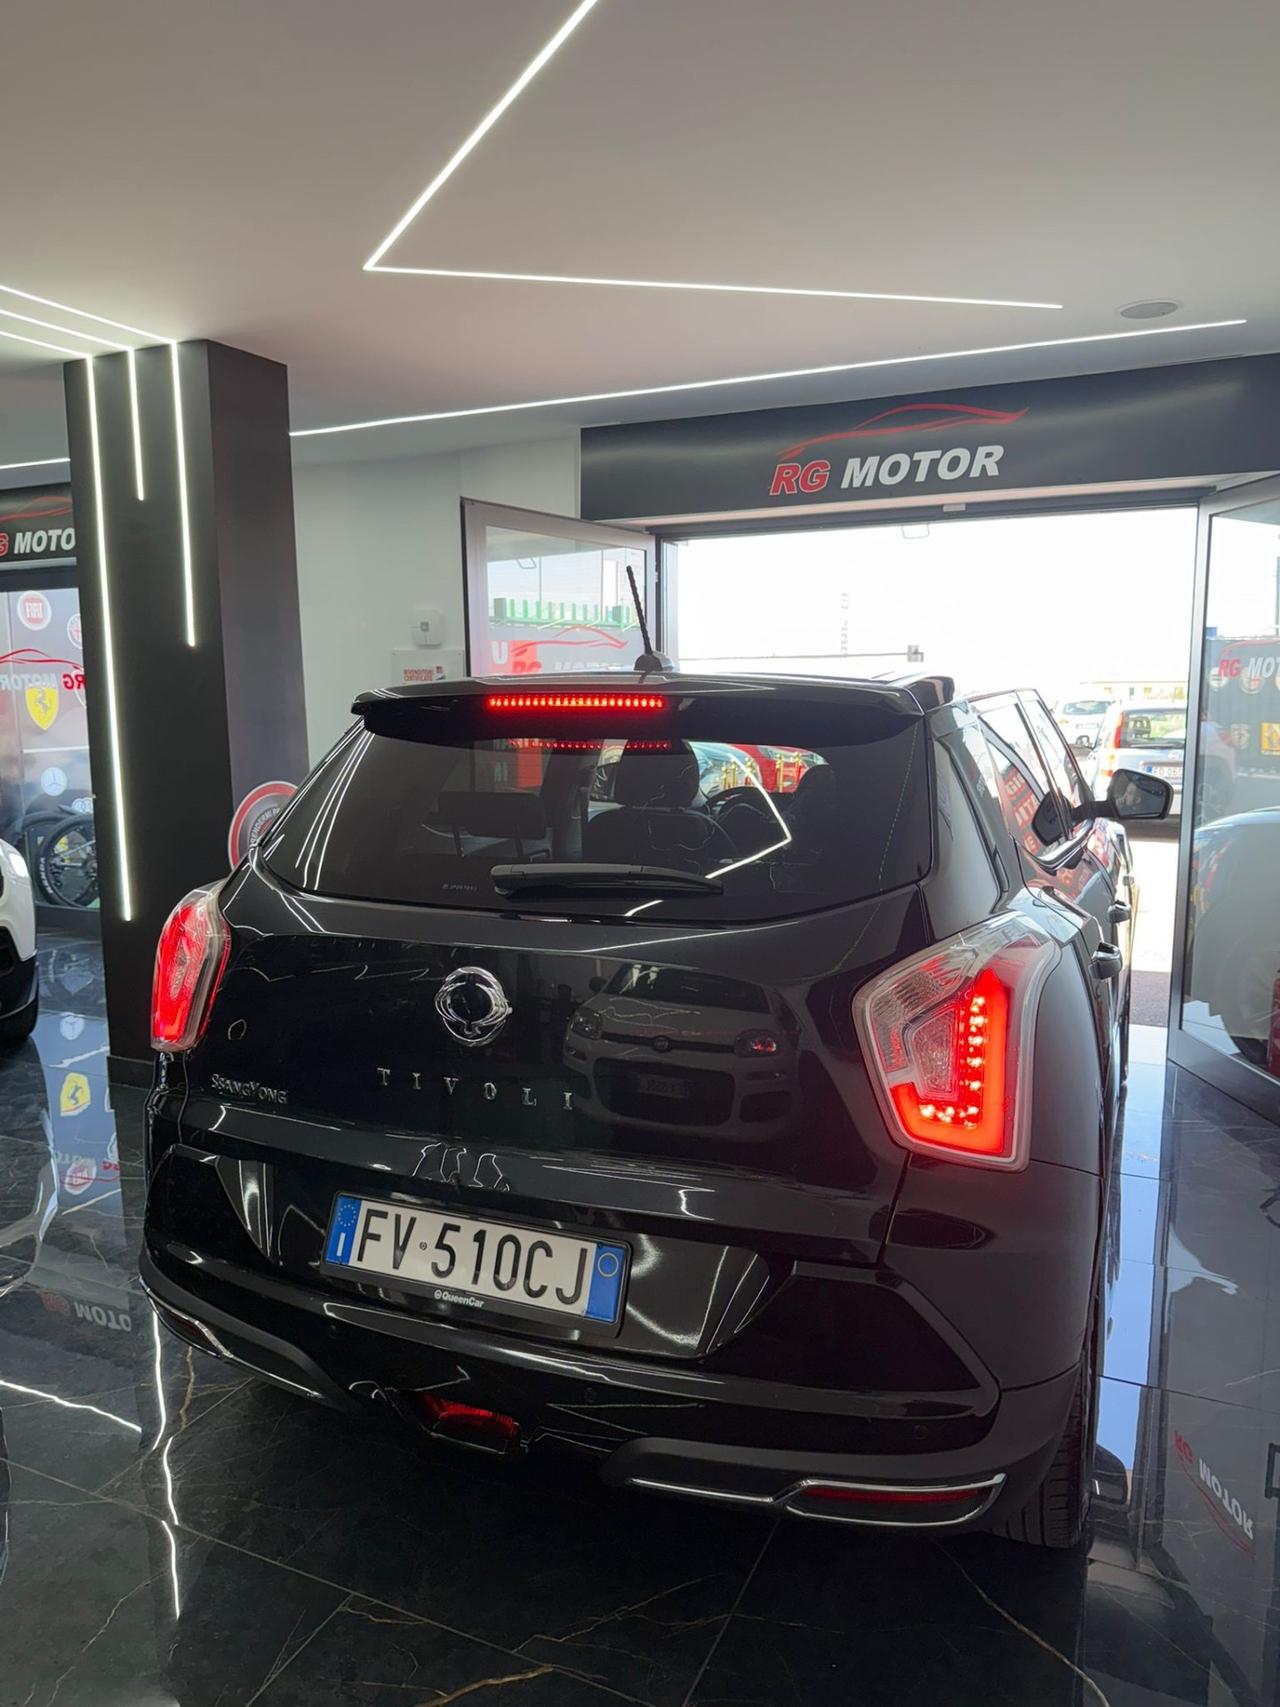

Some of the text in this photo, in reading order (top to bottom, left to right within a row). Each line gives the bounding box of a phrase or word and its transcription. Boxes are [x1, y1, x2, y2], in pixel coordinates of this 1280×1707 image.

[769, 444, 1005, 496] RG MOTOR
[376, 1066, 575, 1112] TIVOLI
[356, 1208, 589, 1306] FV 510CJ
